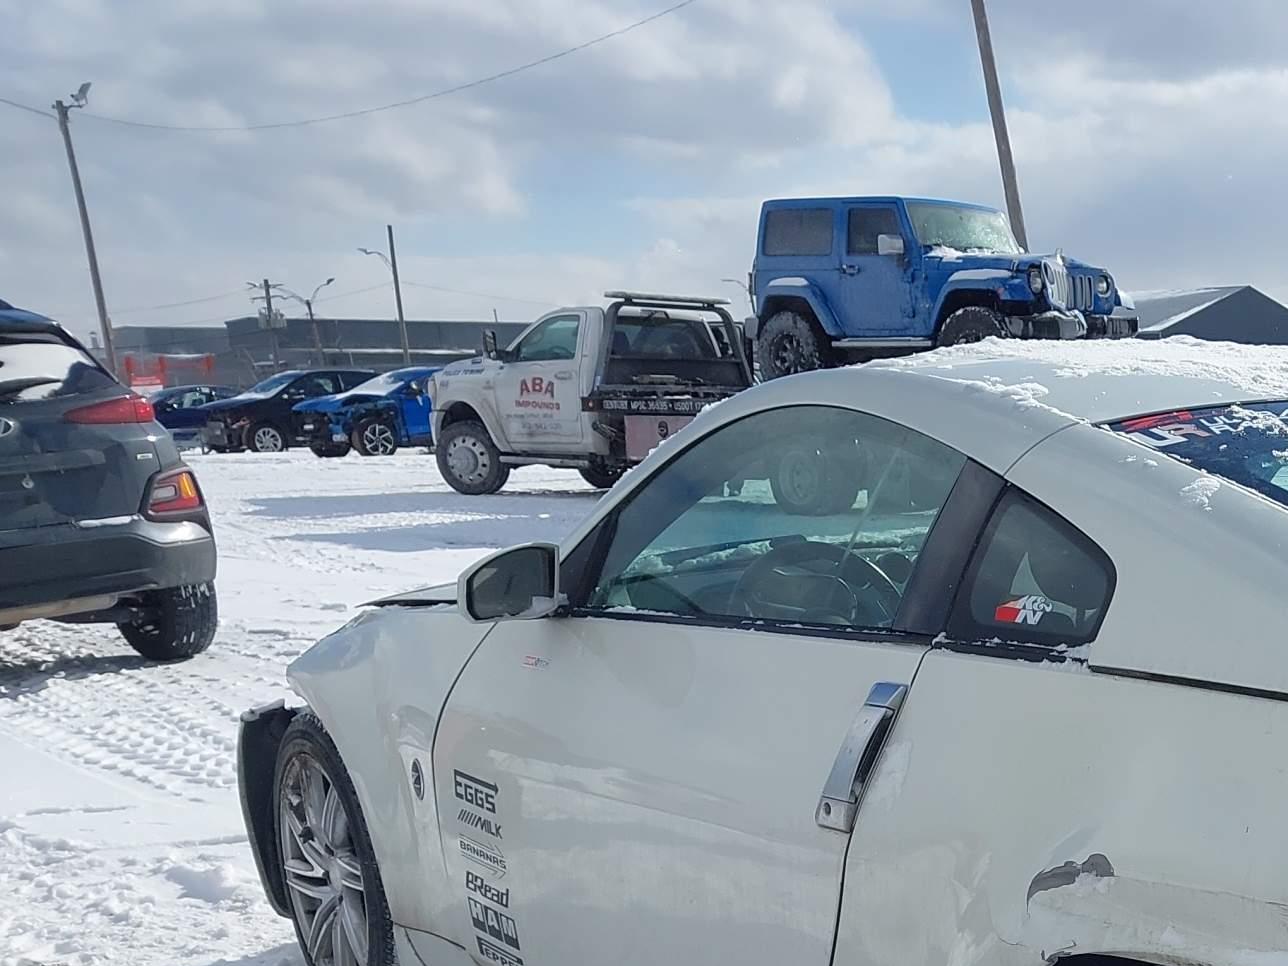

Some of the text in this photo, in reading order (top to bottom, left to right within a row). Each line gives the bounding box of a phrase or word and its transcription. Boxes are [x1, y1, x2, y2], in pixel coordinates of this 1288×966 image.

[520, 376, 555, 399] ABA
[1014, 594, 1053, 625] K&N
[454, 768, 498, 814] EGGS
[460, 839, 507, 870] BANANAS
[467, 896, 520, 951] HAM
